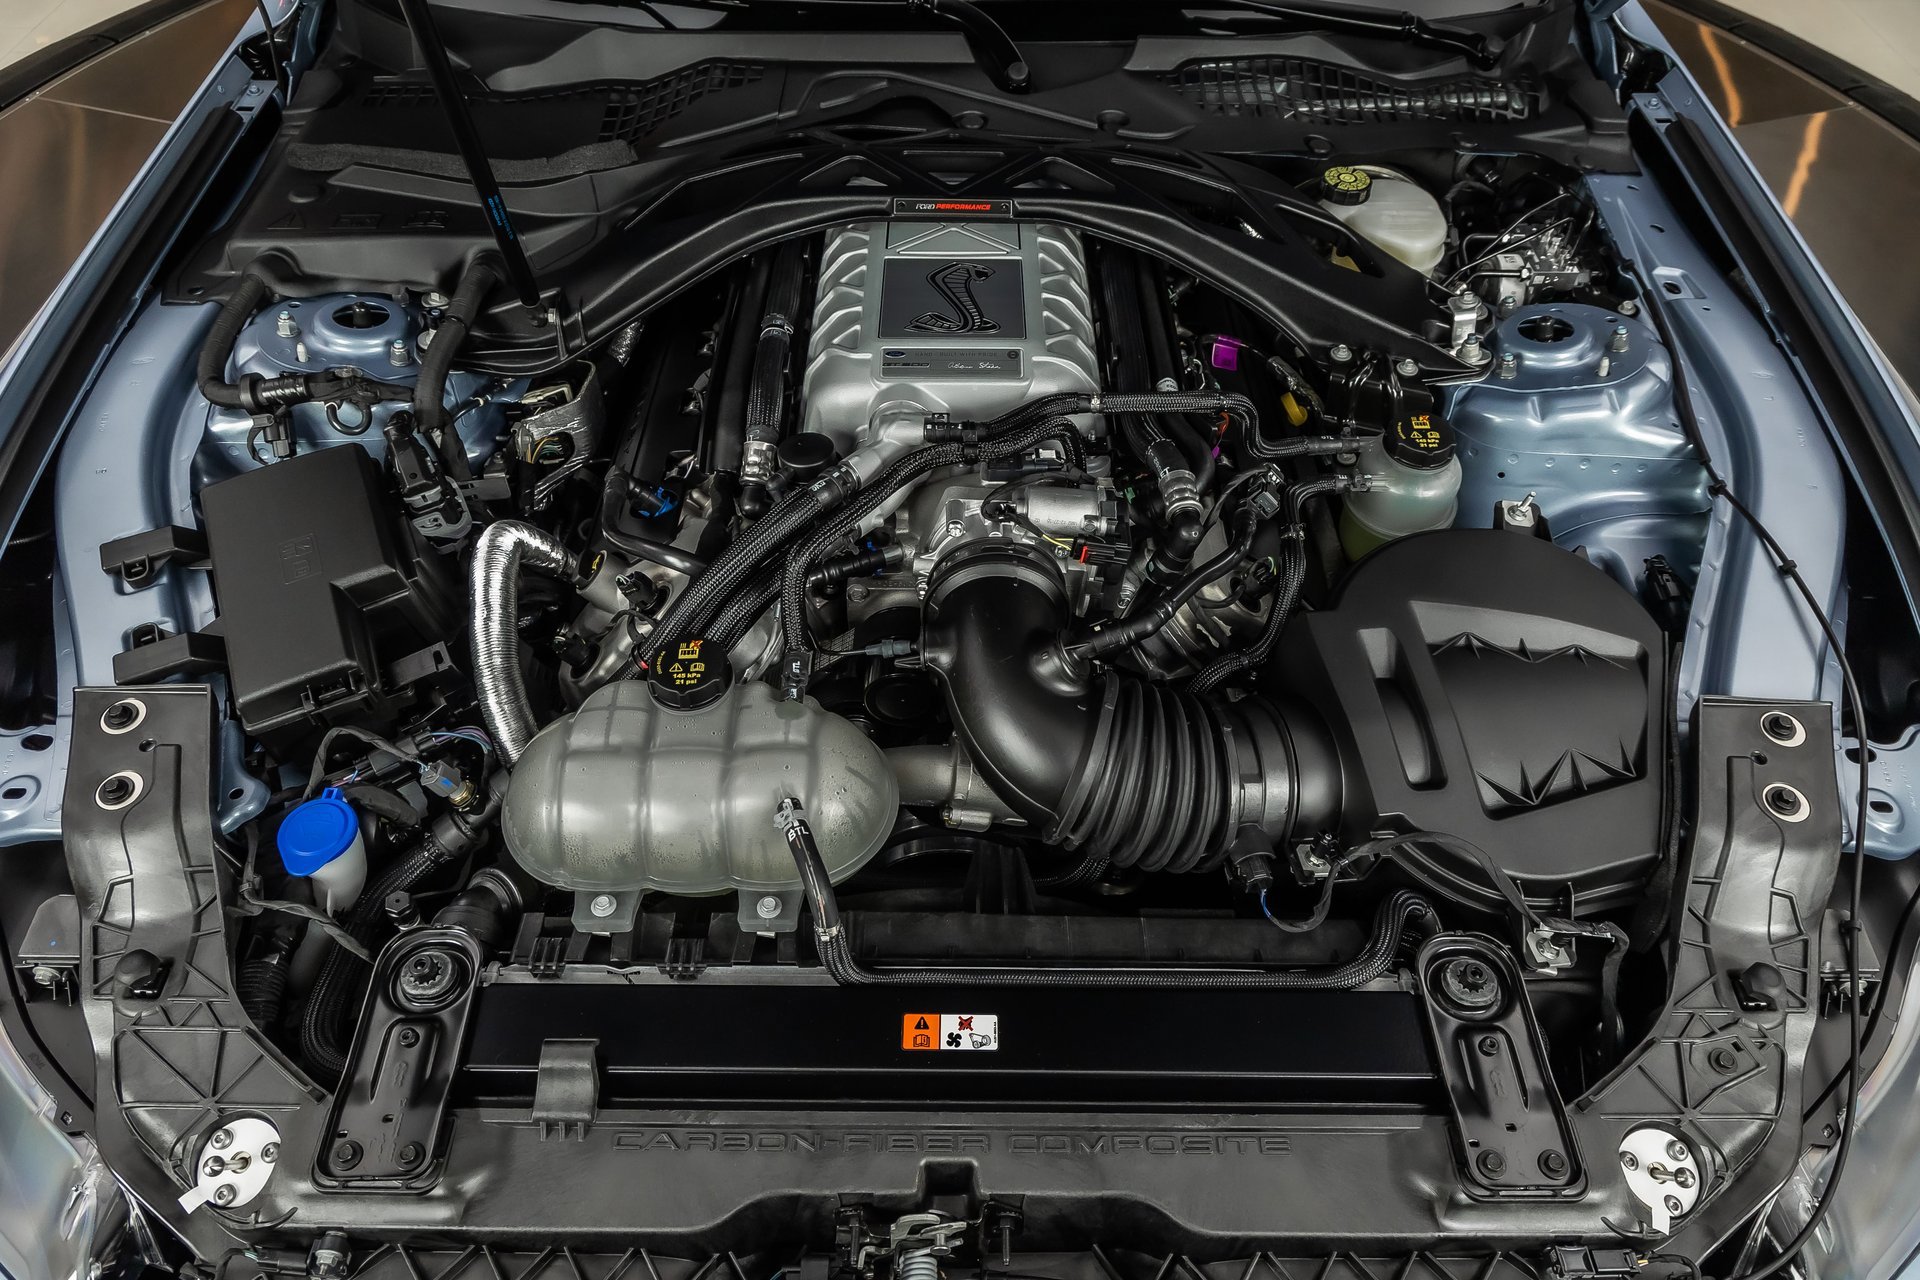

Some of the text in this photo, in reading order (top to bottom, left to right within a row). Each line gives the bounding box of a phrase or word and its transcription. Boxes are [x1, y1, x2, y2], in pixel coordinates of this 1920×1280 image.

[787, 826, 809, 842] BTL
[612, 1131, 1292, 1156] CARBON-FIBER COMPOSITE
